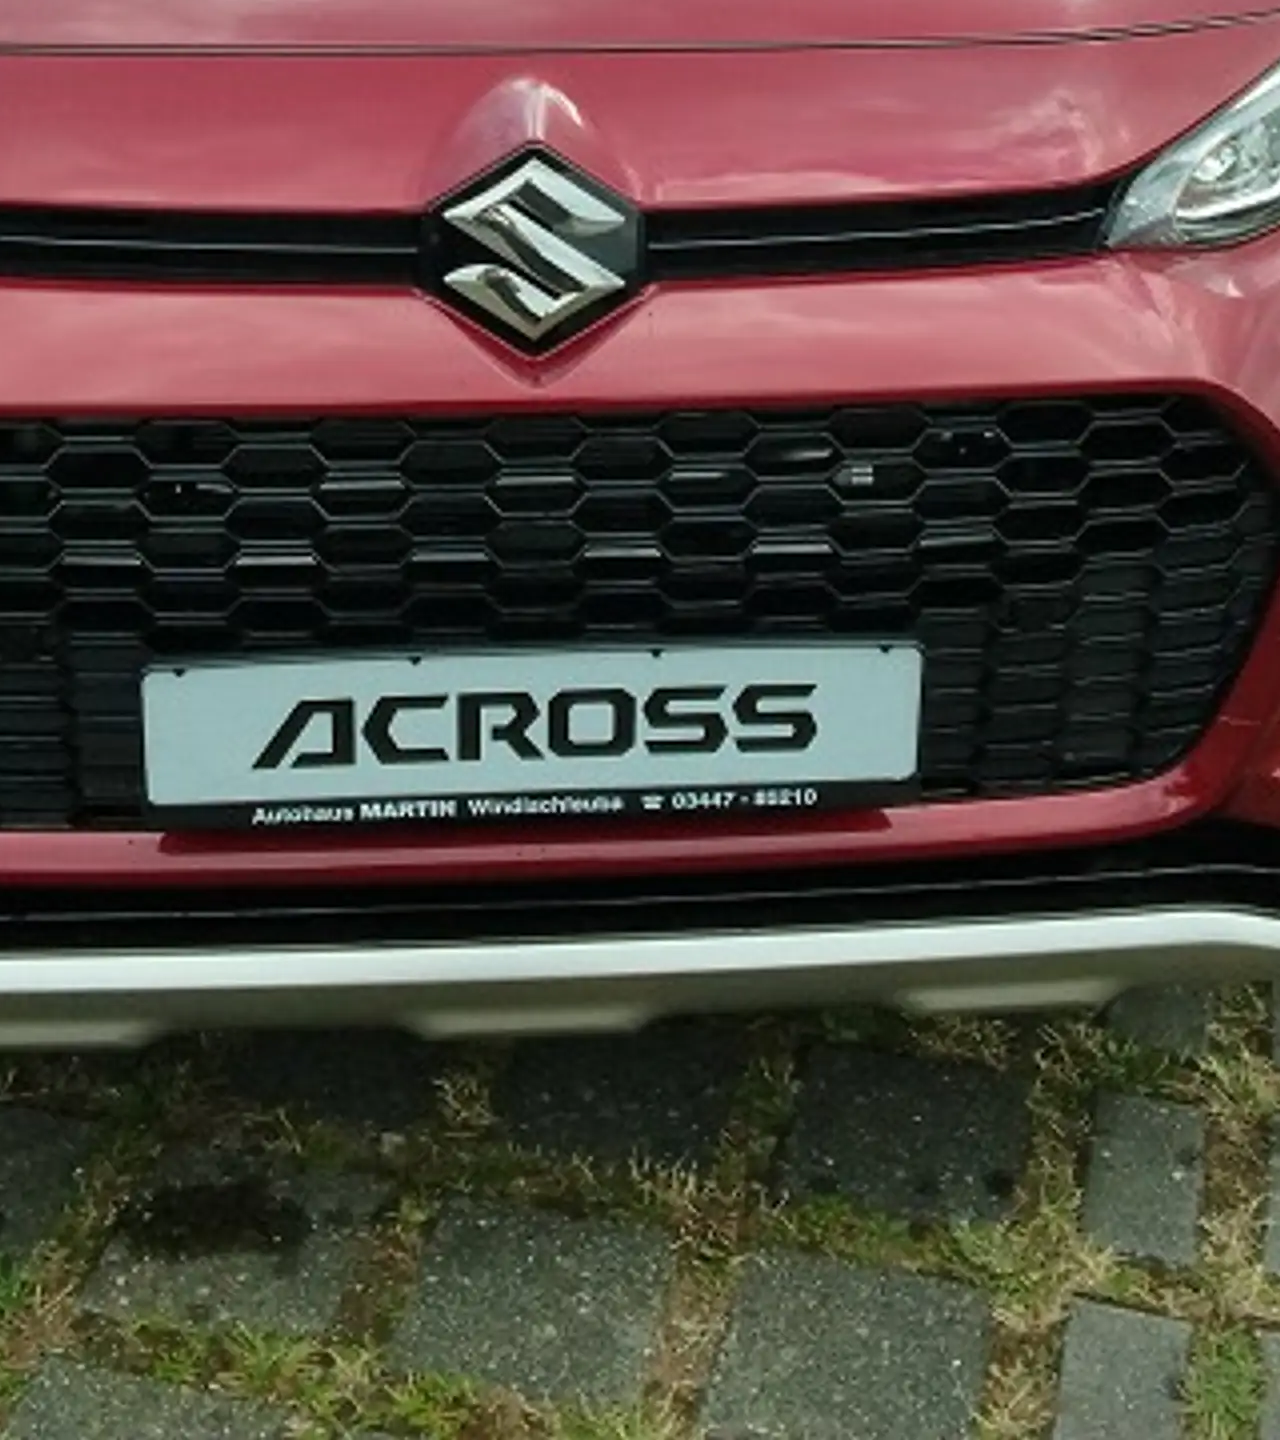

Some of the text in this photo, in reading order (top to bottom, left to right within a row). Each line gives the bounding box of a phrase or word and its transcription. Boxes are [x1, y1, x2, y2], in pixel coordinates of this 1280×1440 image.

[251, 682, 819, 770] ACROSS
[251, 806, 354, 826] Autohaus
[359, 799, 457, 820] MARTIN
[671, 790, 735, 810] 03447
